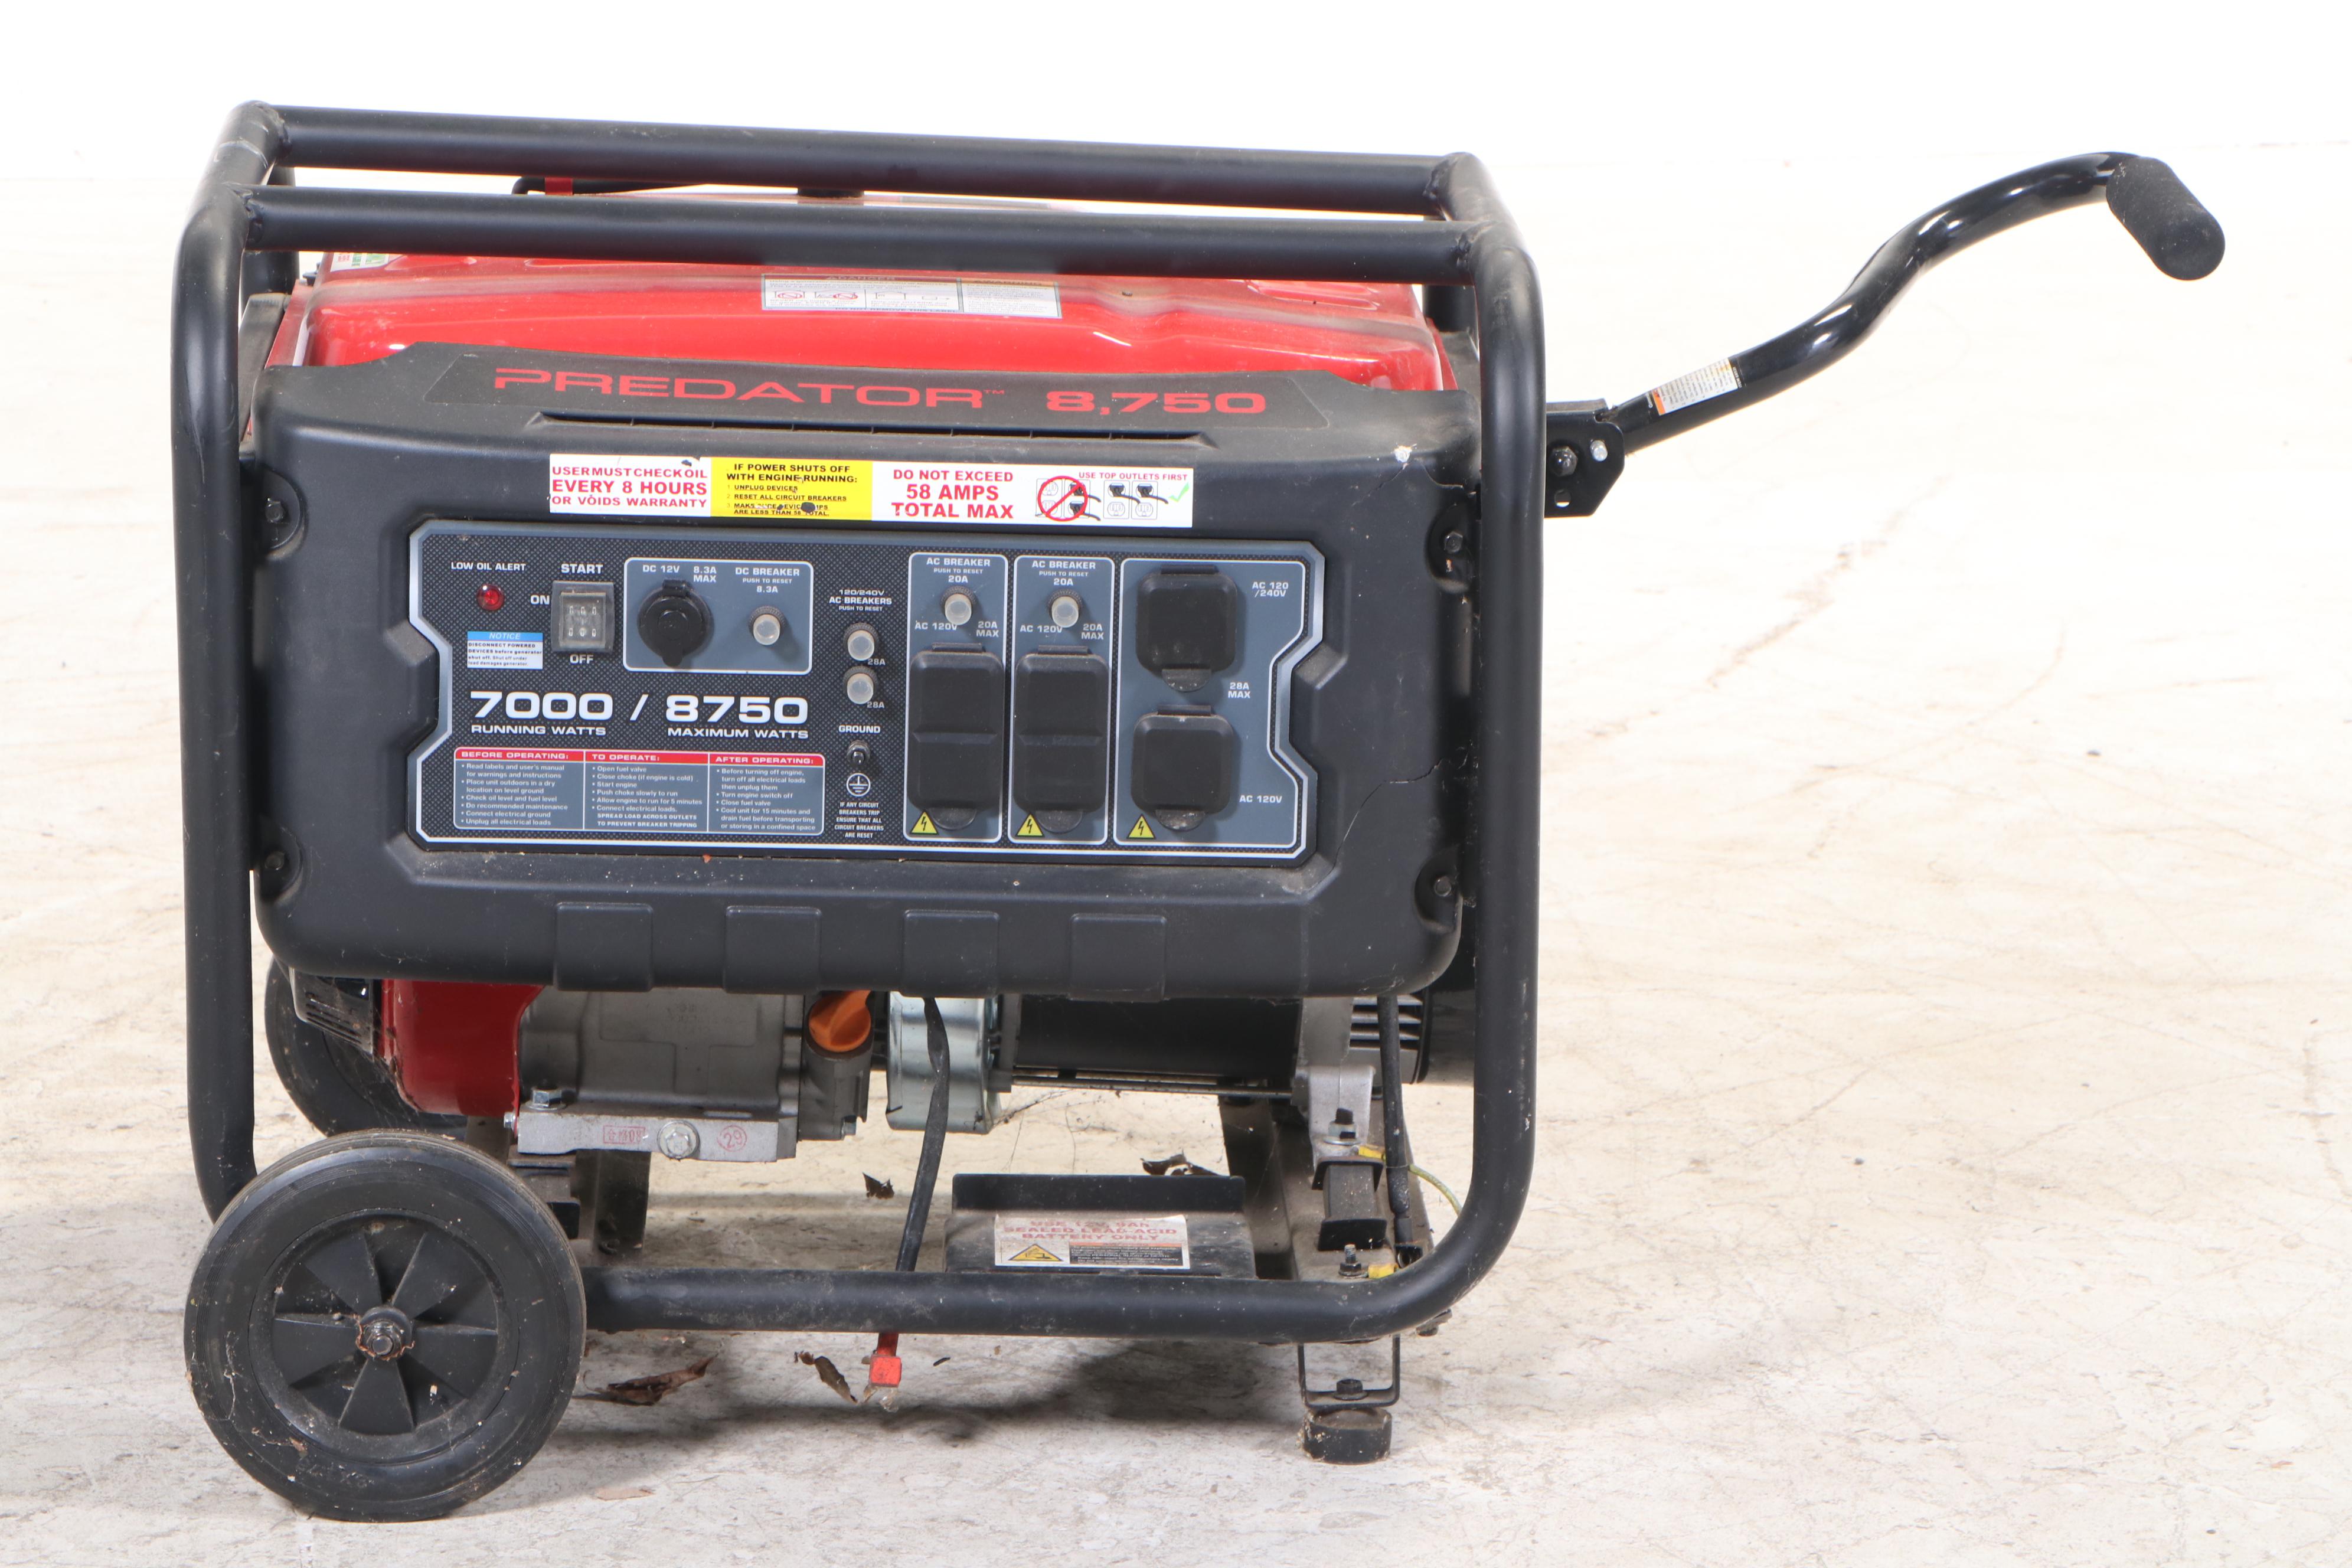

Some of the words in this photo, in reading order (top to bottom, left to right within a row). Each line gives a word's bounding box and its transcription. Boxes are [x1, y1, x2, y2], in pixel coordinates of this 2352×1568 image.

[1046, 391, 1266, 415] 8,750
[552, 466, 590, 475] USER
[592, 468, 632, 476] MUST
[634, 468, 682, 478] CHECK
[684, 469, 707, 478] OIL
[893, 469, 915, 480] DO
[919, 470, 949, 481] NOT
[954, 471, 1014, 482] EXCEED
[1119, 472, 1161, 481] OUTLETS
[1162, 473, 1188, 482] FIRST
[552, 479, 615, 493] EVERY
[622, 481, 632, 494] 8
[641, 481, 707, 495] HOURS
[906, 484, 931, 499] 58
[938, 485, 999, 501] AMPS
[551, 496, 571, 505] OR
[577, 496, 620, 506] VOIDS
[626, 497, 707, 507] WARRANTY
[891, 502, 961, 517] TOTAL
[966, 504, 1014, 519] MAX
[451, 561, 473, 570] LOW
[476, 562, 492, 570] OIL
[495, 563, 527, 571] ALERT
[926, 558, 942, 566] AC
[943, 558, 991, 567] BREAKER
[1032, 560, 1046, 569] AC
[1048, 561, 1096, 570] BREAKER
[561, 563, 603, 574] START
[642, 564, 656, 573] DC
[660, 565, 680, 573] 12V
[693, 566, 717, 574] 8.3A
[753, 567, 800, 576] BREAKER
[693, 574, 716, 583] MAX
[948, 575, 968, 583] 20A
[1053, 578, 1073, 586] 20A
[756, 585, 778, 593] 8.3A
[1252, 581, 1267, 589] AC
[1269, 582, 1289, 590] 120
[530, 594, 550, 605] ON
[844, 597, 892, 605] BREAKERS
[914, 622, 928, 630] AC
[932, 622, 958, 631] 120V
[1037, 625, 1063, 634] 120V
[1083, 623, 1103, 632] 20A
[976, 629, 999, 638] MAX
[1081, 632, 1104, 640] MAX
[570, 654, 593, 665] OFF
[1230, 682, 1249, 690] 28A
[1228, 691, 1250, 699] MAX
[471, 691, 613, 720] 7000
[629, 694, 649, 721] /
[665, 695, 808, 724] 8750
[471, 724, 546, 734] RUNNING
[551, 726, 606, 736] WATTS
[668, 727, 749, 738] MAXIMUM
[754, 729, 809, 739] WATTS
[838, 725, 881, 733] GROUND
[1256, 795, 1282, 803] 120V
